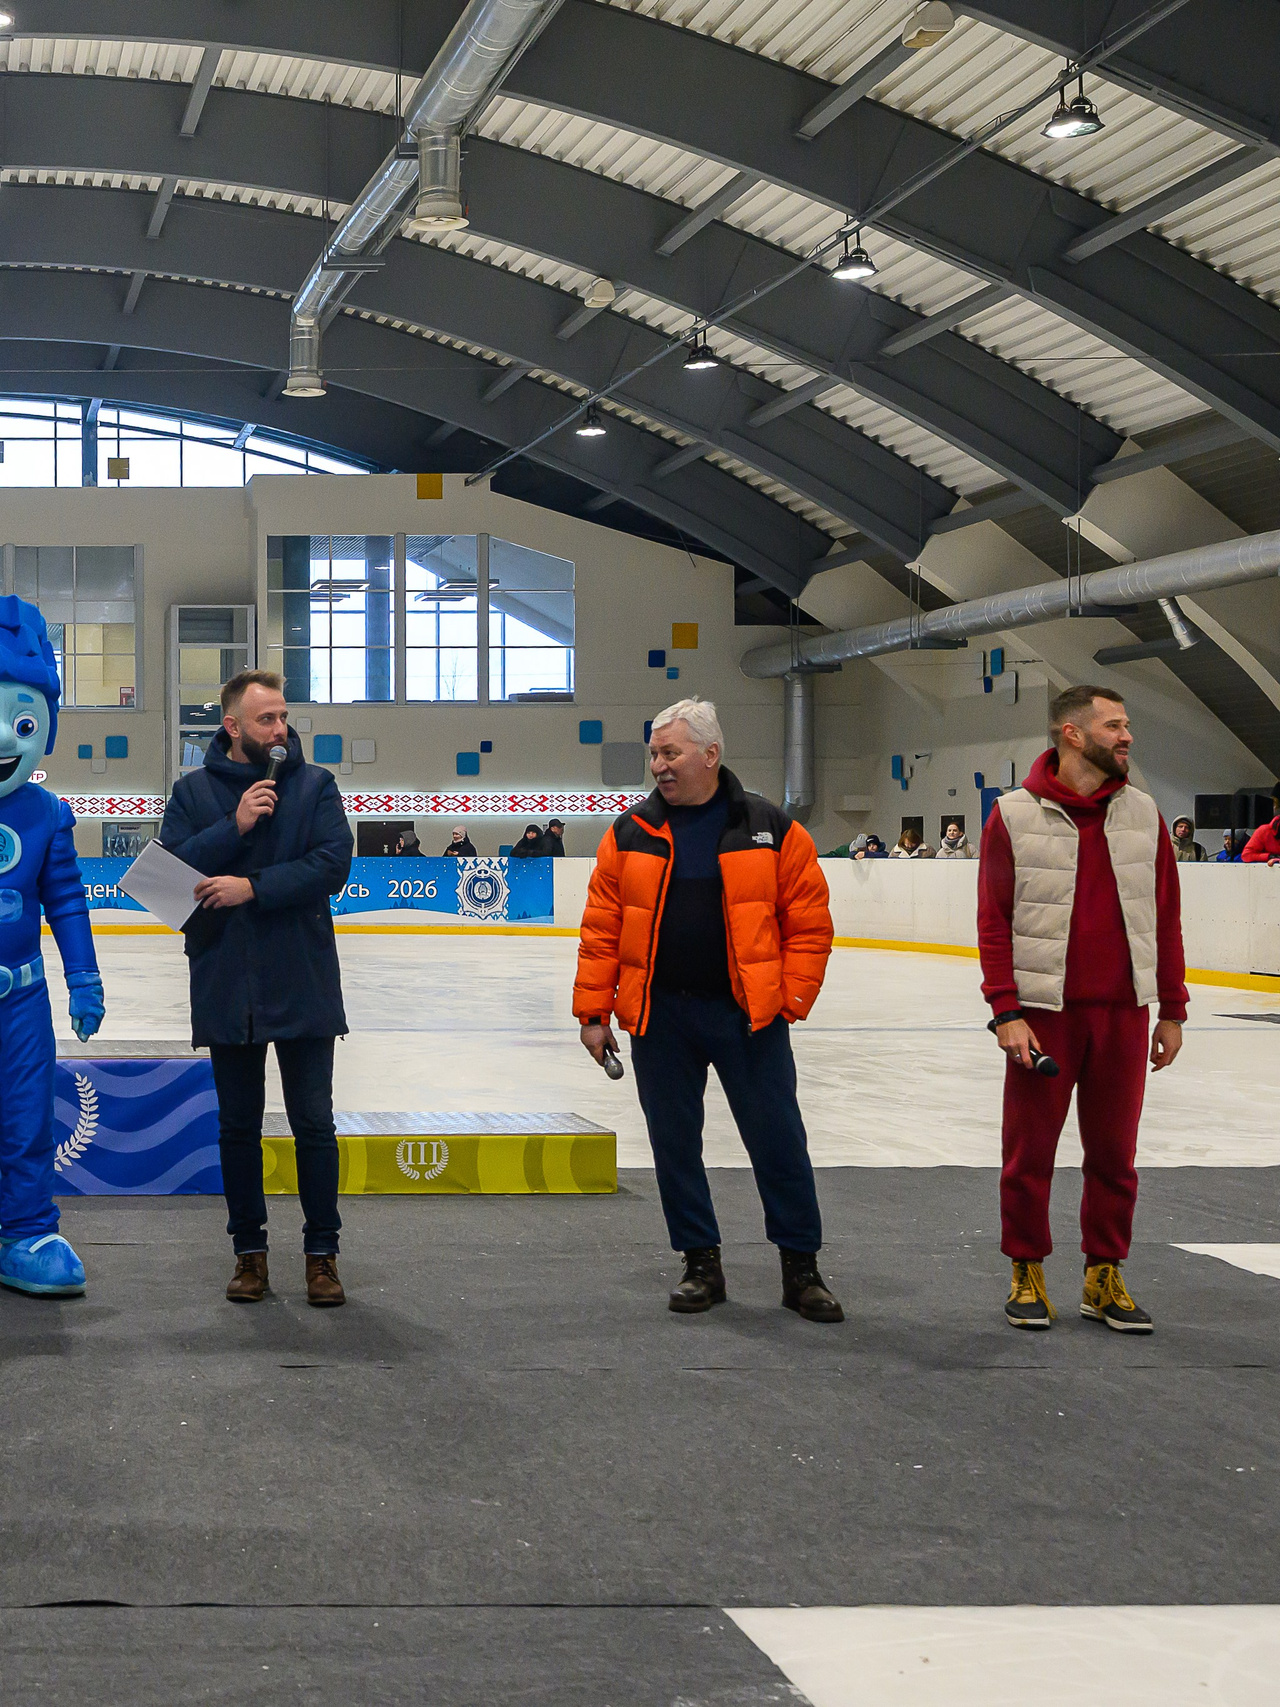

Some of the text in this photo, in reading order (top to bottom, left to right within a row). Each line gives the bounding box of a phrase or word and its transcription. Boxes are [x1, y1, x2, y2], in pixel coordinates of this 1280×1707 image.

[329, 883, 370, 902] усь
[387, 879, 438, 898] 2026
[404, 1141, 441, 1165] III
